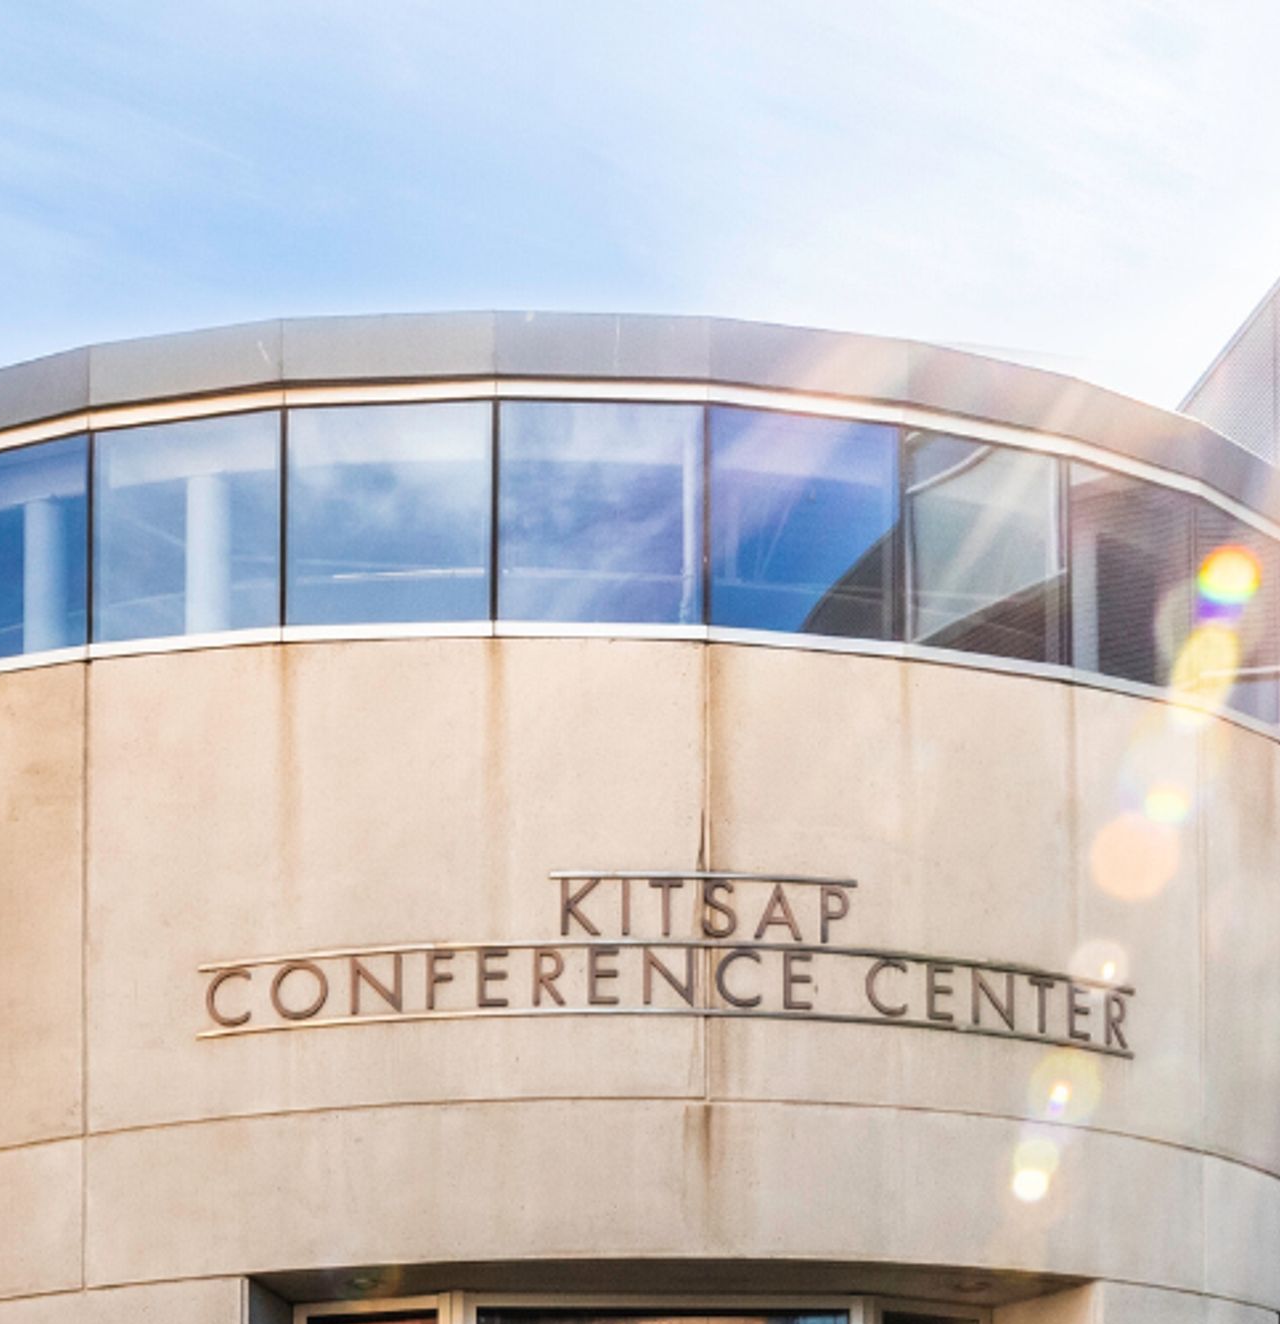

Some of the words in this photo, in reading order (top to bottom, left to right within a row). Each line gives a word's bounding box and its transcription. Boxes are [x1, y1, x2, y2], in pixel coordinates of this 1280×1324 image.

[559, 877, 851, 943] KITSAP
[206, 945, 814, 1027] CONFERENCE
[865, 960, 1129, 1048] CENTER
